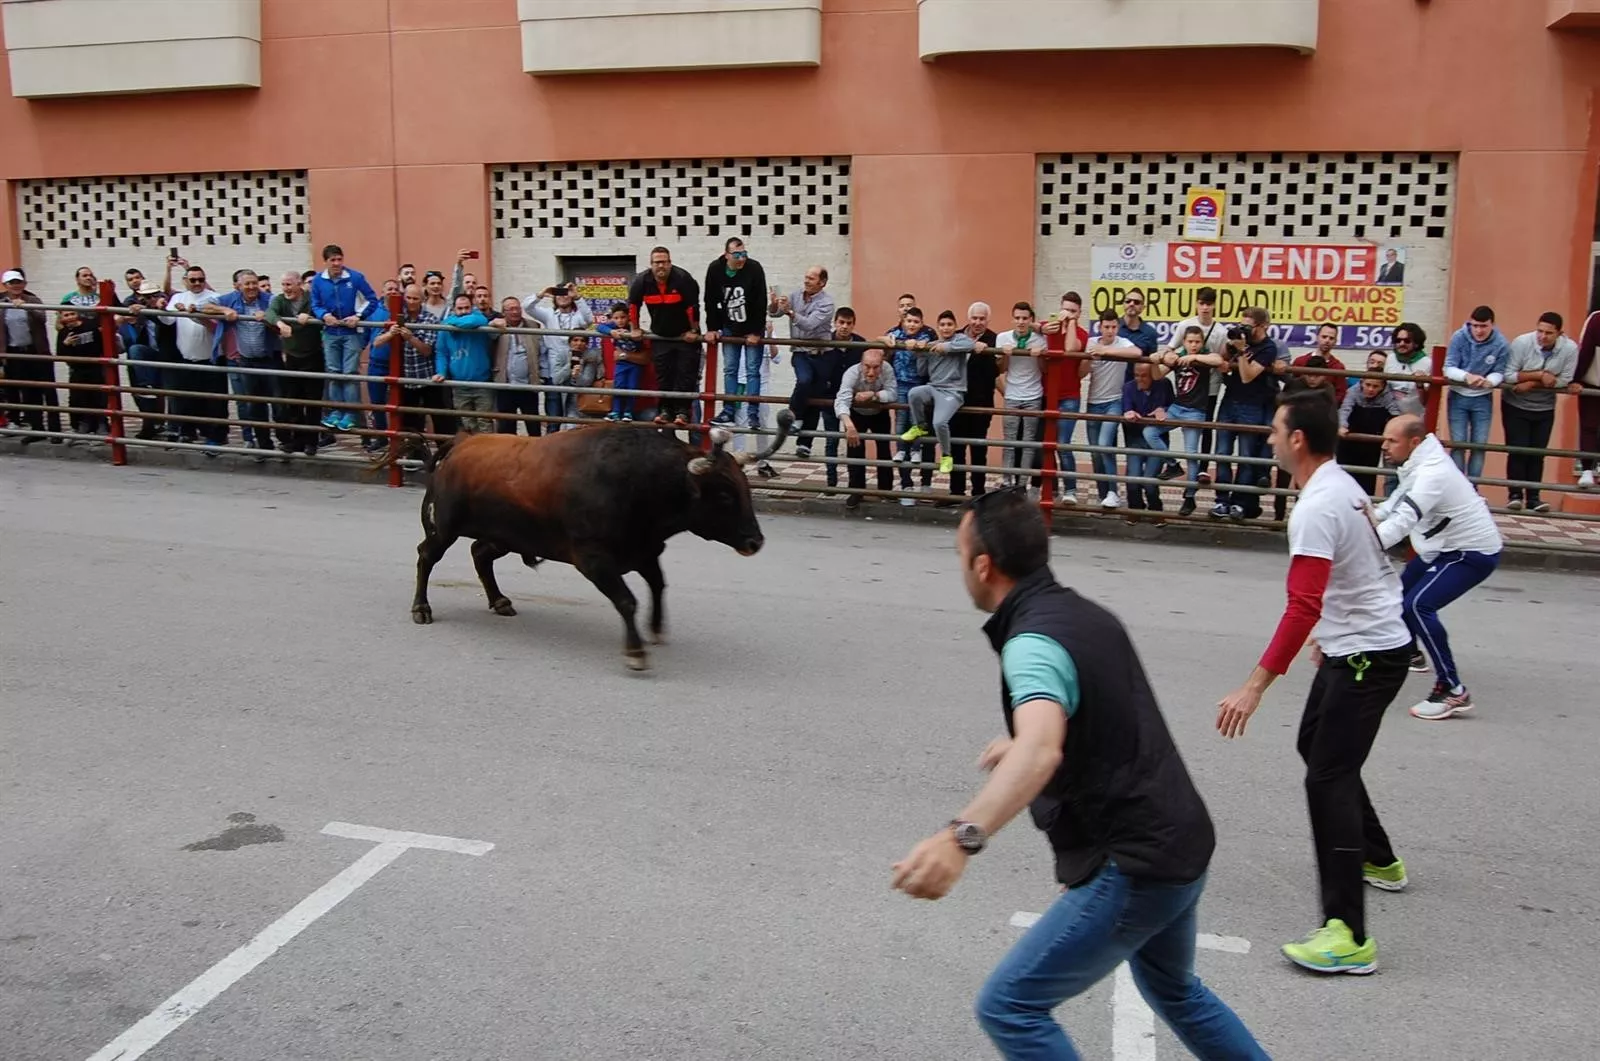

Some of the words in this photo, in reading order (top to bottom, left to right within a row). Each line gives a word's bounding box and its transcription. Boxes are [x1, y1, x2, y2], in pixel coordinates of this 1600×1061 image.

[1173, 245, 1222, 279] SE
[1234, 246, 1367, 282] VENDE
[1100, 272, 1156, 281] ASESORES
[1093, 286, 1294, 319] OPRTUDAD!!!
[1304, 286, 1396, 304] ULTIMOS
[1299, 305, 1399, 323] LOCALES
[1303, 325, 1343, 345] 51
